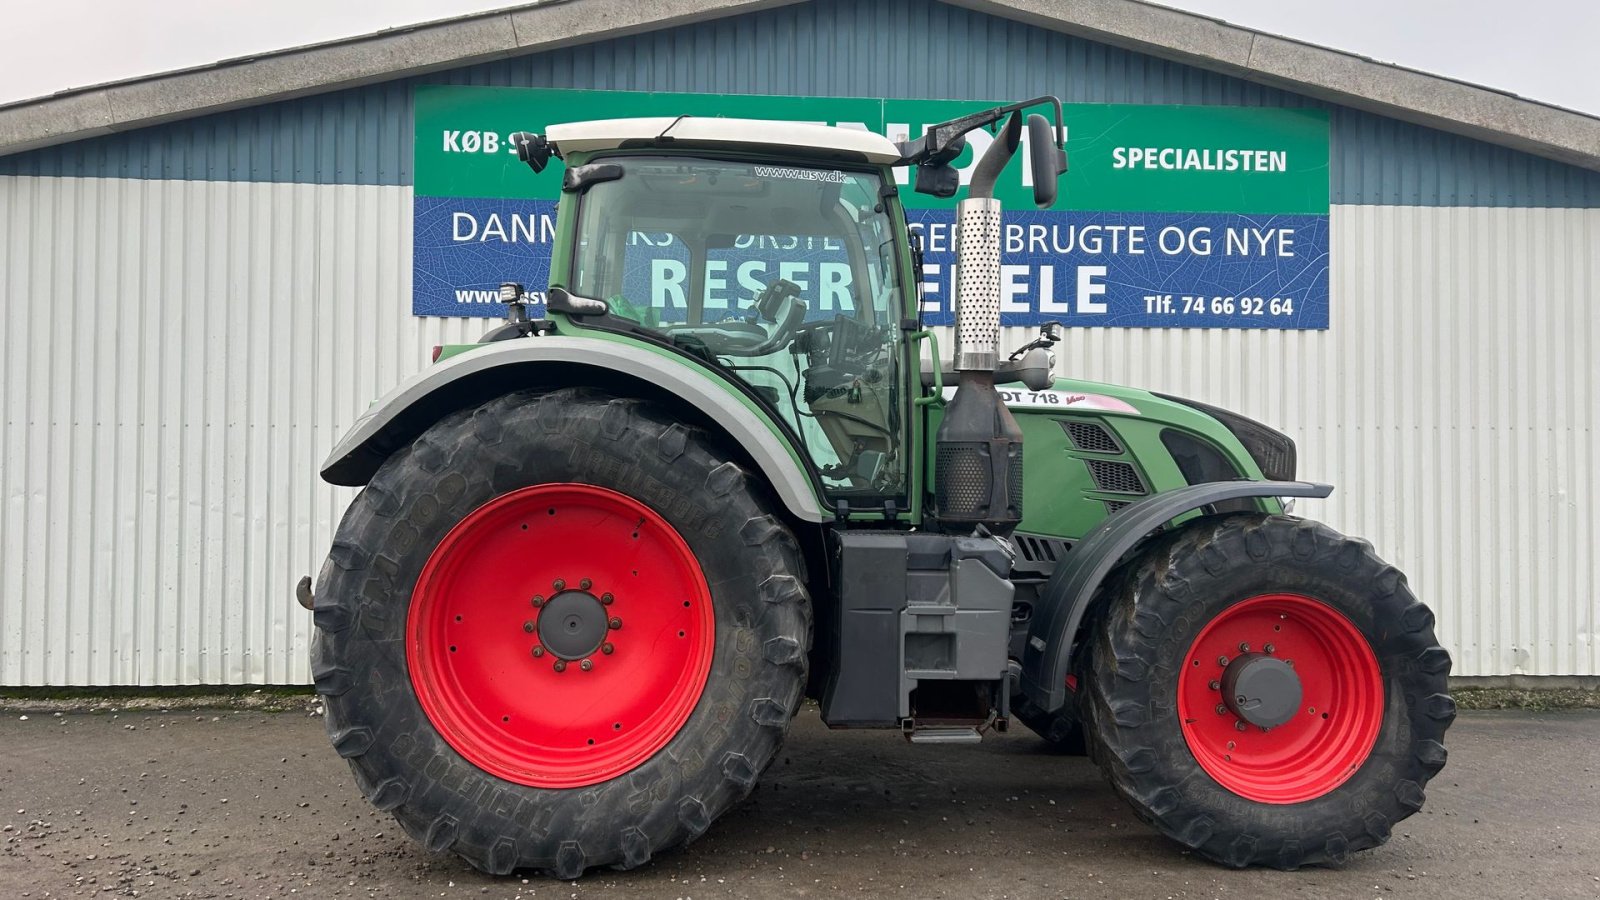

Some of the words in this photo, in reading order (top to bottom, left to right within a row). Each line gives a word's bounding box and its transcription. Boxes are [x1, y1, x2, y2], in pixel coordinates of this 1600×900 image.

[1112, 147, 1286, 172] SPECIALISTEN
[754, 166, 846, 183] www.usv.dk
[1006, 224, 1145, 253] BRUGTE
[1158, 226, 1211, 255] OG
[1227, 227, 1294, 257] NYE
[1144, 296, 1176, 313] Tlf.
[1182, 297, 1205, 314] 74
[1211, 298, 1234, 314] 66
[1241, 298, 1264, 315] 92
[1269, 298, 1293, 315] 64
[1028, 393, 1059, 404] 718
